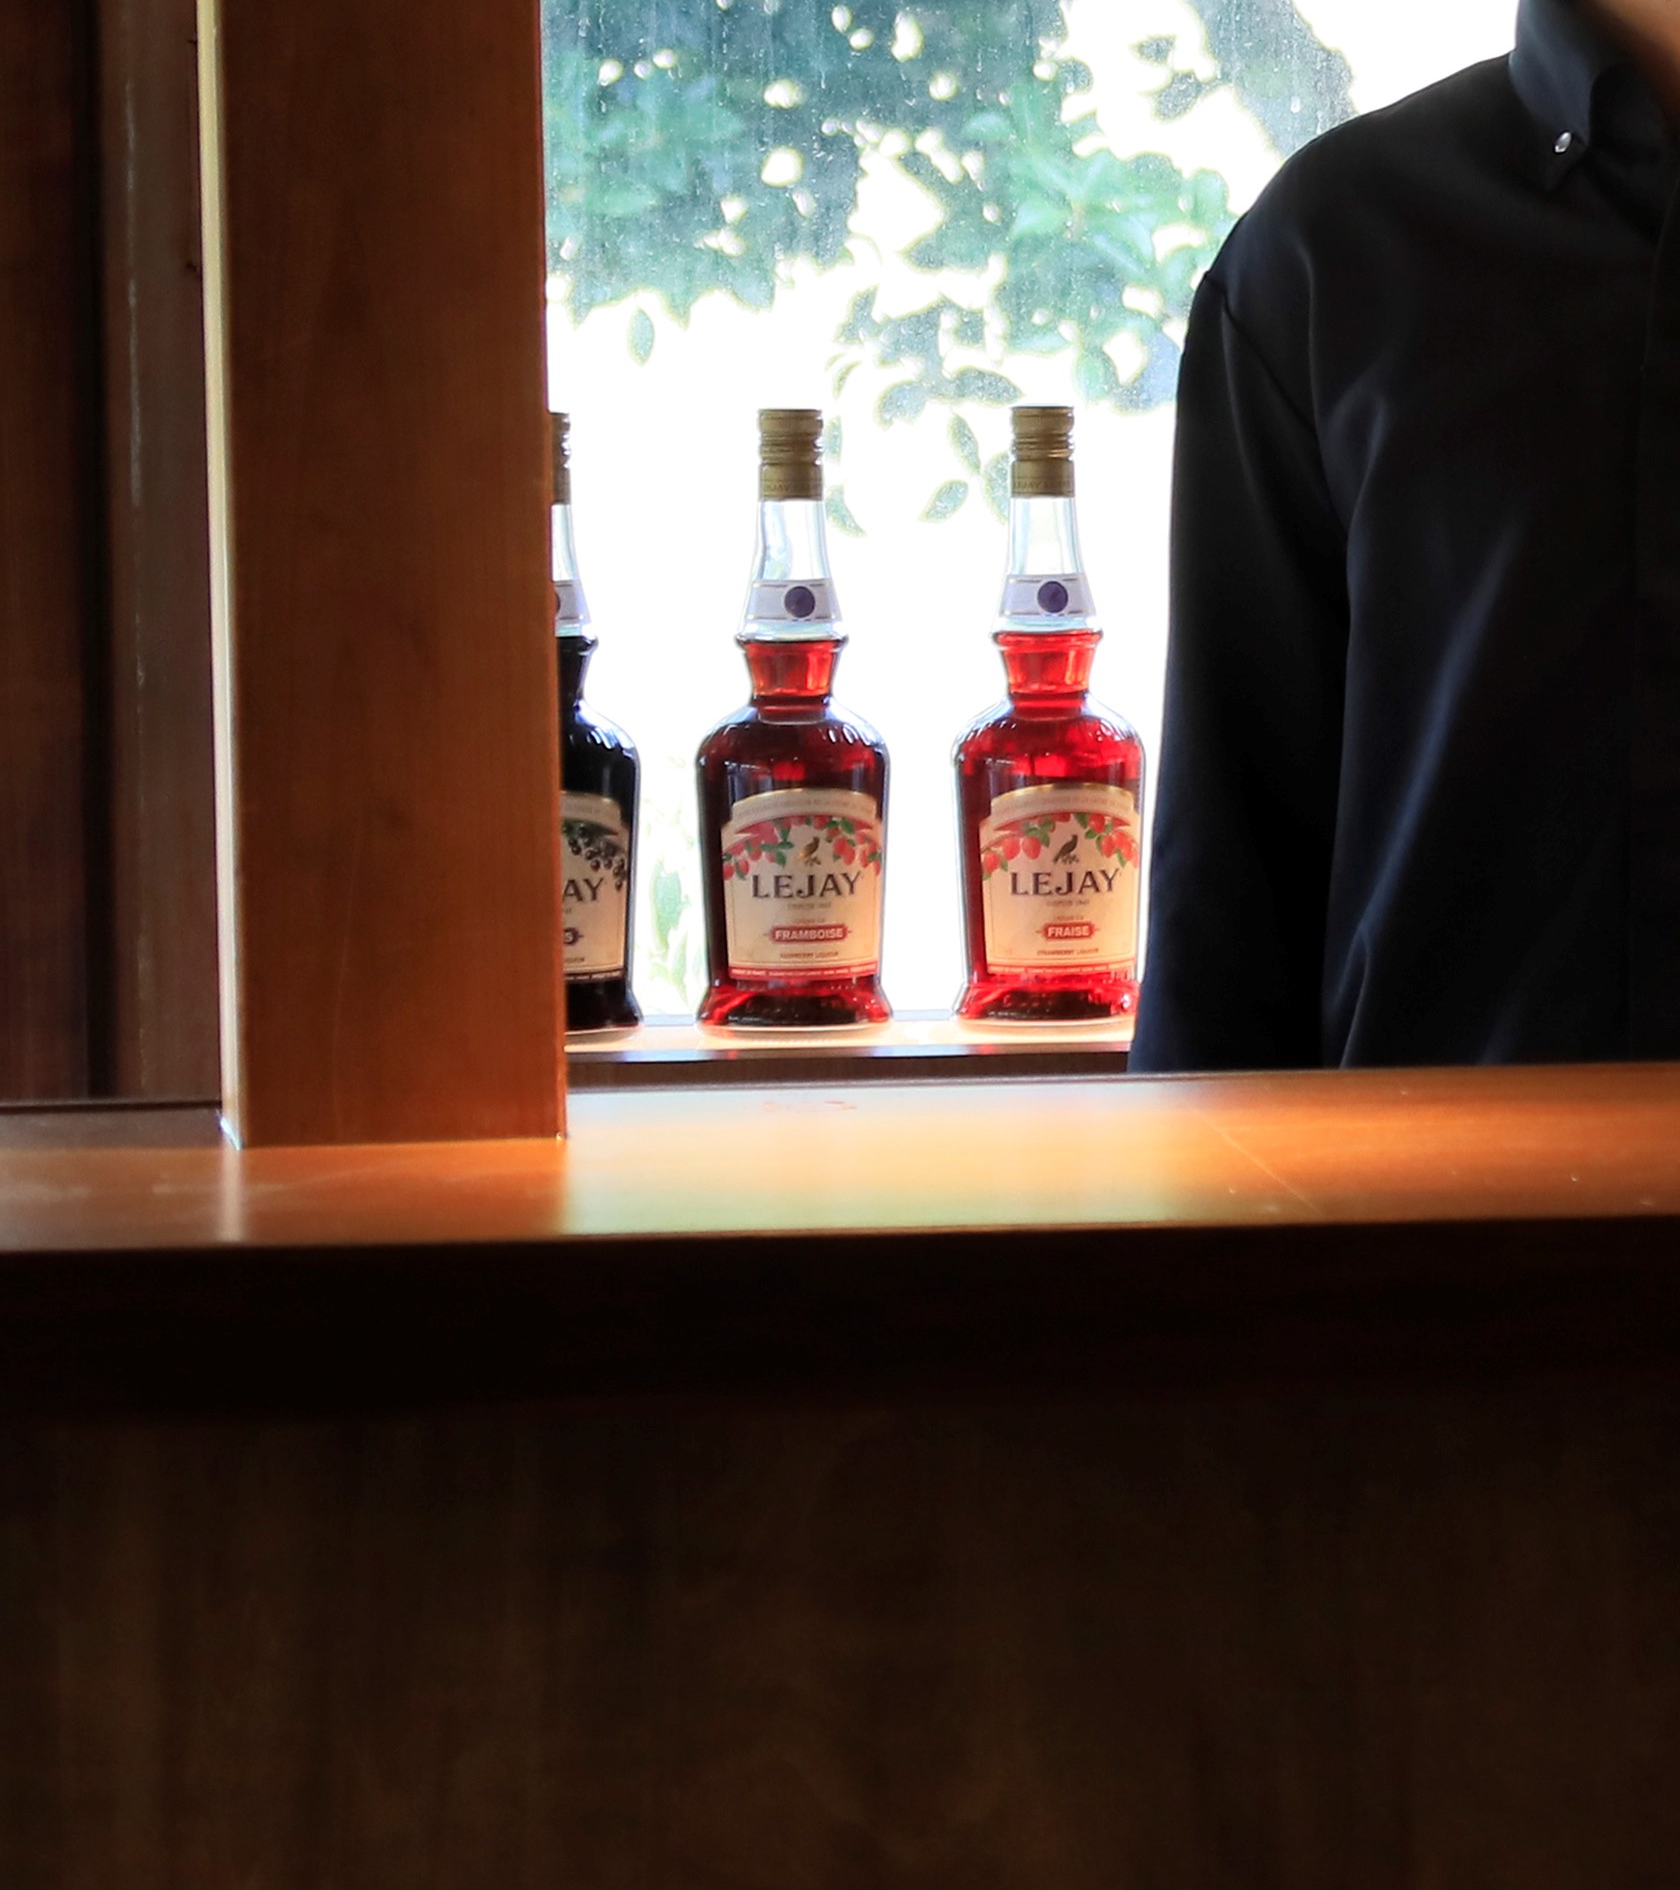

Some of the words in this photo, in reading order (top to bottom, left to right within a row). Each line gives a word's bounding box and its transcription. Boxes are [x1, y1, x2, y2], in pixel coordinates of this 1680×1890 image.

[751, 871, 861, 899] LEJAY
[1010, 868, 1119, 896] LEJAY
[775, 928, 844, 940] FRAMBOISE
[1047, 925, 1090, 938] FRAISE
